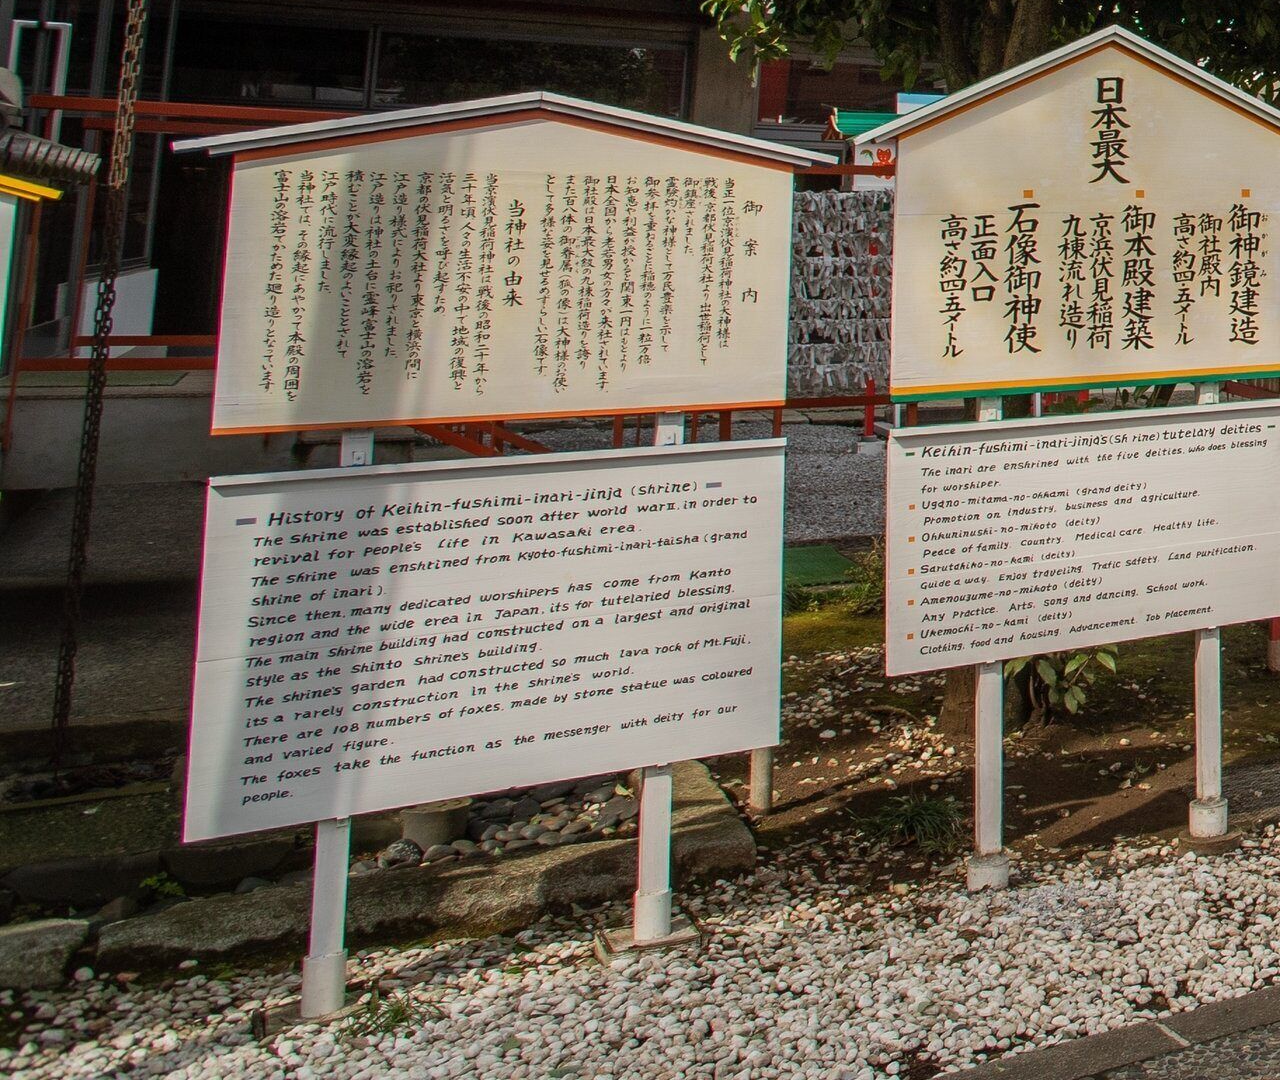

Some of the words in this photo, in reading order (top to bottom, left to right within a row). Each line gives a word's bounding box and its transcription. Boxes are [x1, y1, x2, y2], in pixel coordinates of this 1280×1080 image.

[1088, 77, 1131, 183] 日本最大
[501, 199, 527, 307] 当神社の由来
[970, 215, 999, 301] 正面入口
[1003, 203, 1041, 353] 石像御神使
[1057, 214, 1087, 349] 九棟流れ造り
[1086, 213, 1114, 349] 京浜伏見稲荷
[1121, 205, 1156, 350] 御本殿建築
[1198, 213, 1223, 297] 御社殿内
[1227, 204, 1262, 345] 御神鏡建造
[253, 536, 284, 547] The
[357, 527, 389, 538] was
[395, 516, 491, 535] established
[497, 514, 533, 526] soon
[539, 510, 580, 522] after
[587, 505, 628, 518] world
[683, 500, 697, 510] in
[702, 497, 739, 508] order
[742, 495, 758, 504] to
[267, 510, 344, 527] History
[356, 505, 376, 519] of
[381, 487, 622, 517] Keihin-fushimi-inari-jinja
[631, 481, 697, 497] (shrine)
[254, 549, 320, 567] revival
[327, 548, 355, 560] for
[481, 536, 500, 546] in
[512, 526, 592, 543] Kawasaki
[245, 656, 272, 668] The
[278, 650, 319, 664] main
[378, 635, 437, 652] building
[442, 630, 469, 644] had
[476, 619, 564, 640] constructed
[571, 619, 590, 629] on
[594, 617, 604, 625] a
[614, 609, 663, 625] largest
[669, 605, 695, 617] and
[699, 598, 751, 614] original
[247, 614, 297, 628] Since
[350, 605, 392, 617] many
[399, 594, 472, 612] dedicated
[567, 582, 593, 593] has
[603, 578, 640, 588] come
[647, 574, 681, 584] from
[689, 567, 732, 581] Kanto
[246, 717, 269, 728] its
[273, 715, 284, 723] a
[294, 705, 344, 720] rarely
[352, 690, 459, 712] construction
[471, 686, 487, 696] in
[494, 682, 519, 693] the
[527, 672, 581, 688] shrine's
[240, 775, 267, 786] The
[277, 766, 321, 782] foxes
[333, 759, 371, 773] take
[379, 754, 401, 766] the
[410, 744, 476, 761] function
[485, 739, 503, 749] as
[513, 735, 535, 746] the
[543, 724, 611, 741] messenger
[620, 717, 648, 730] with
[653, 712, 684, 724] deity
[691, 708, 712, 719] for
[717, 705, 738, 715] our
[244, 753, 273, 765] and
[282, 743, 334, 760] varied
